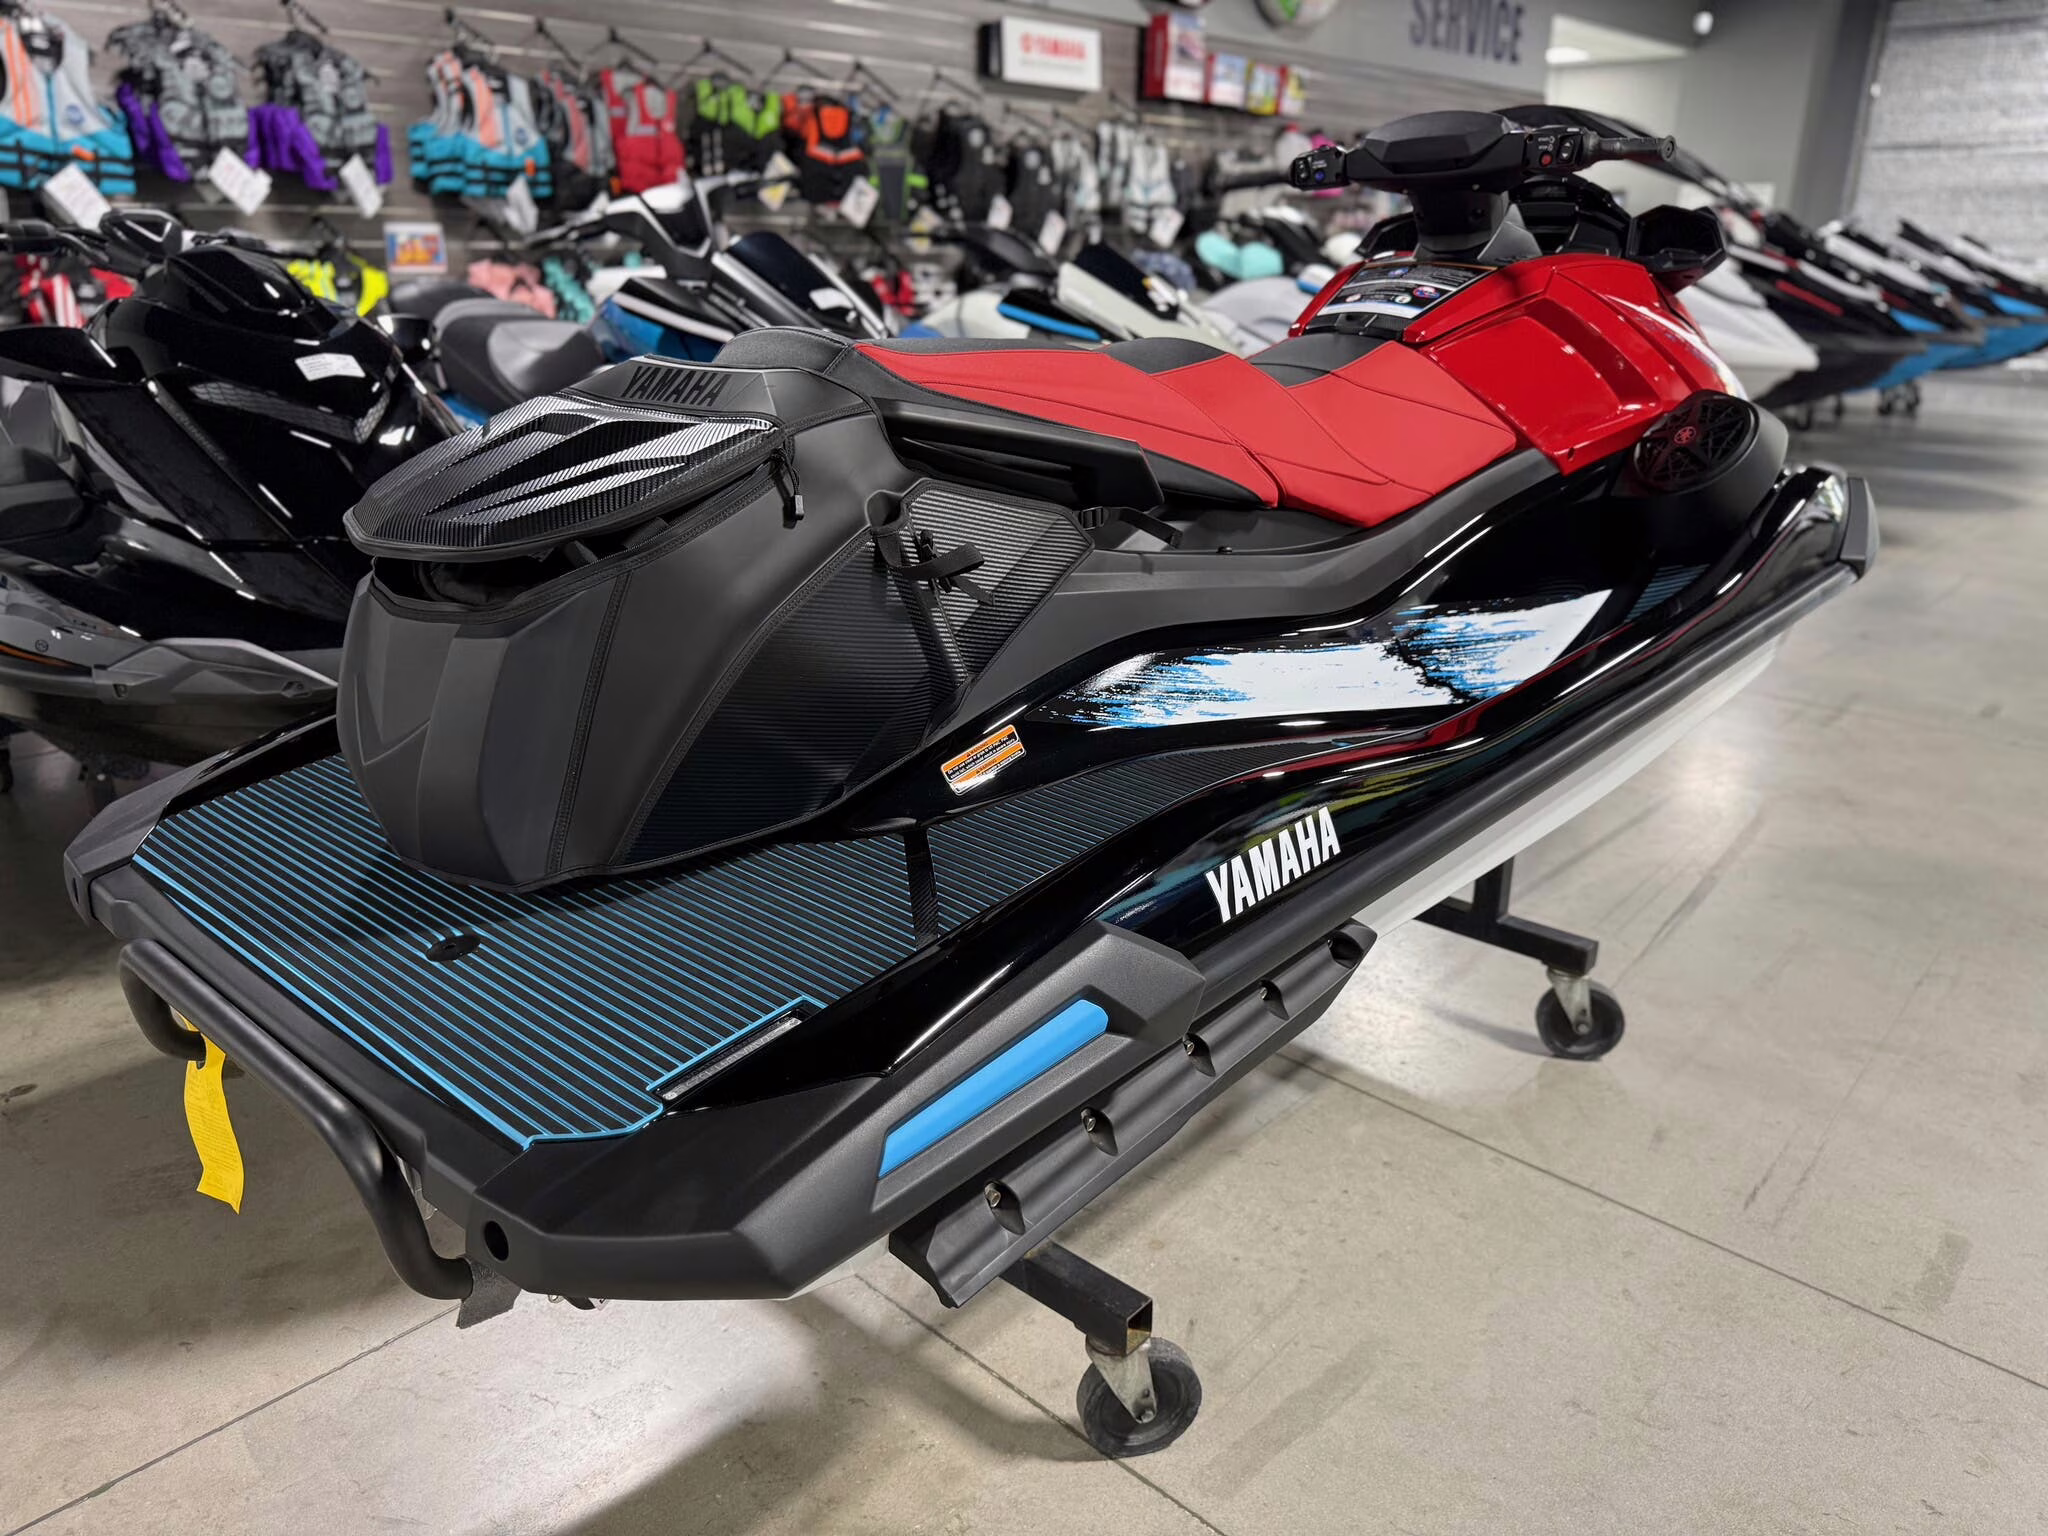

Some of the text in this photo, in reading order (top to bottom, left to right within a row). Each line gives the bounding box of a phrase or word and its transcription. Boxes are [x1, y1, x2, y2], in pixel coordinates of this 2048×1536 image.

[1408, 0, 1523, 65] SERVICE
[620, 365, 732, 407] YAMAHA
[1205, 806, 1341, 923] YAMAHA
